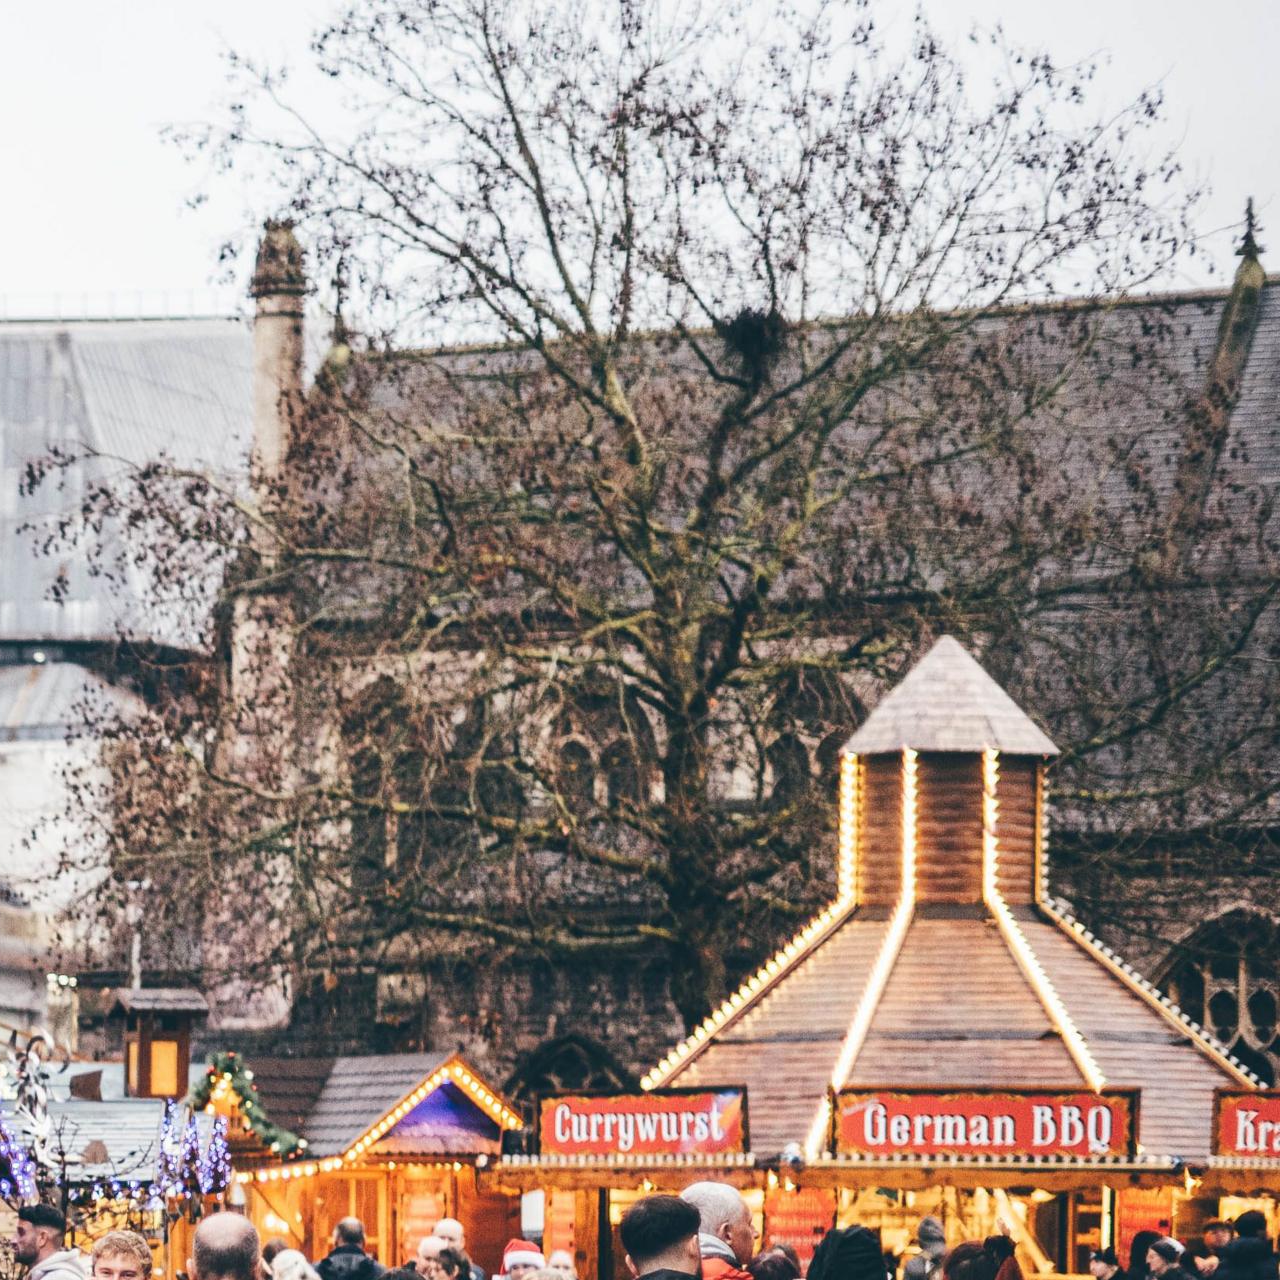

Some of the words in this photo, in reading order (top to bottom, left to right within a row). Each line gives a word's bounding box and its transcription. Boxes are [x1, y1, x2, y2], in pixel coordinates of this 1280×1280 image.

[555, 1102, 724, 1152] Currywurst
[863, 1102, 1016, 1147] German
[1031, 1104, 1112, 1154] BBQ
